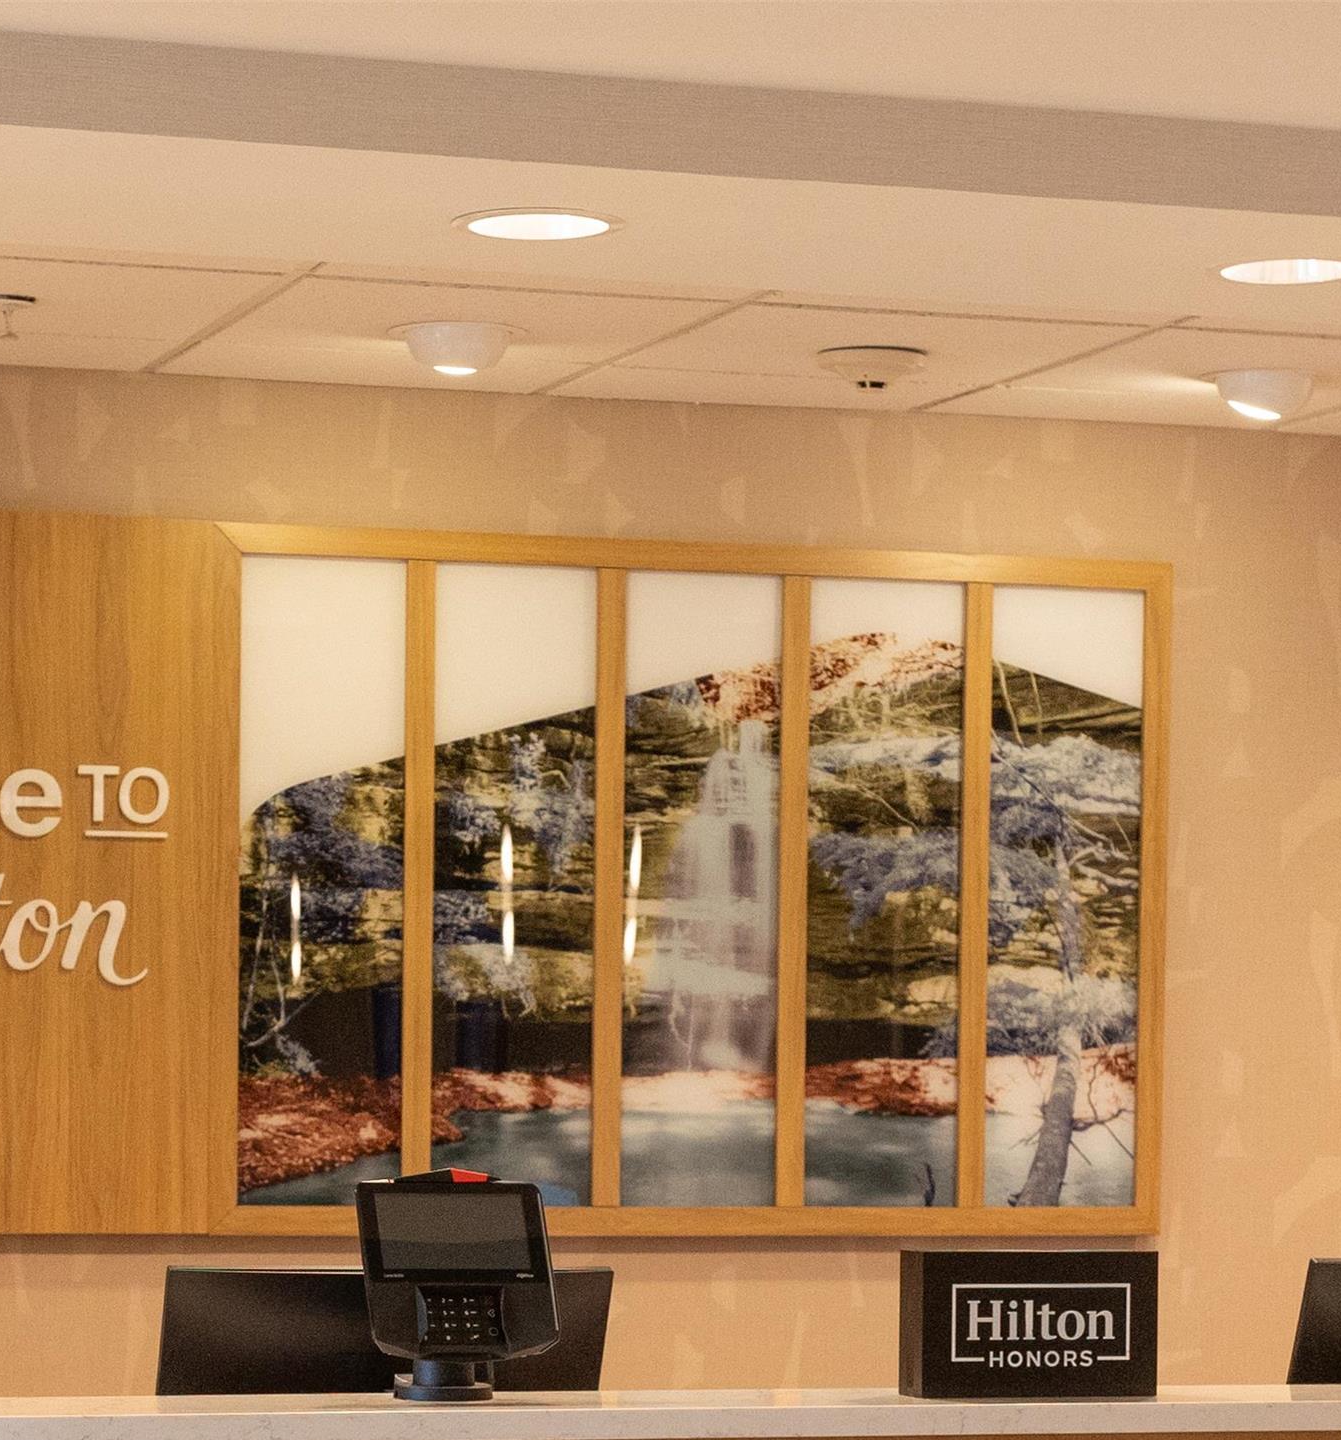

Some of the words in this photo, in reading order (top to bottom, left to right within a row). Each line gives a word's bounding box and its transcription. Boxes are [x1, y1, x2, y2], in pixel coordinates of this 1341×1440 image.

[77, 763, 171, 825] TO
[966, 1300, 1116, 1341] Hilton
[989, 1350, 1094, 1367] HONORS
